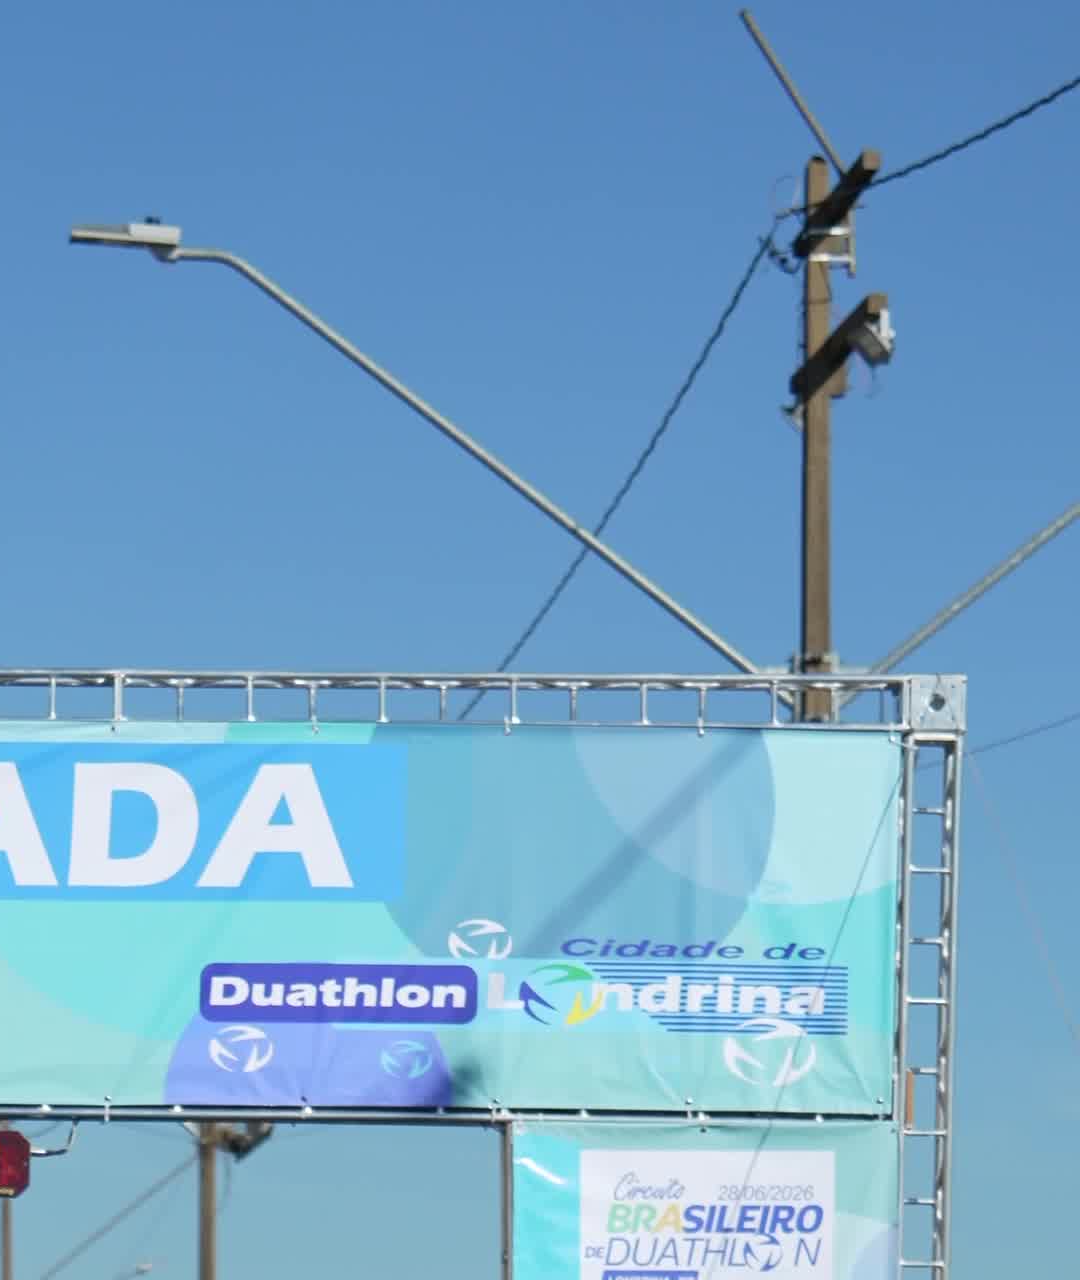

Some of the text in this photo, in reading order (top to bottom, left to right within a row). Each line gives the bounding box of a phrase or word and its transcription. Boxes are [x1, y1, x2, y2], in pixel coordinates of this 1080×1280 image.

[561, 938, 825, 961] Cidade de
[209, 975, 467, 1009] Duathlon
[606, 1203, 824, 1234] BRASILEIRO
[584, 1246, 605, 1259] DE
